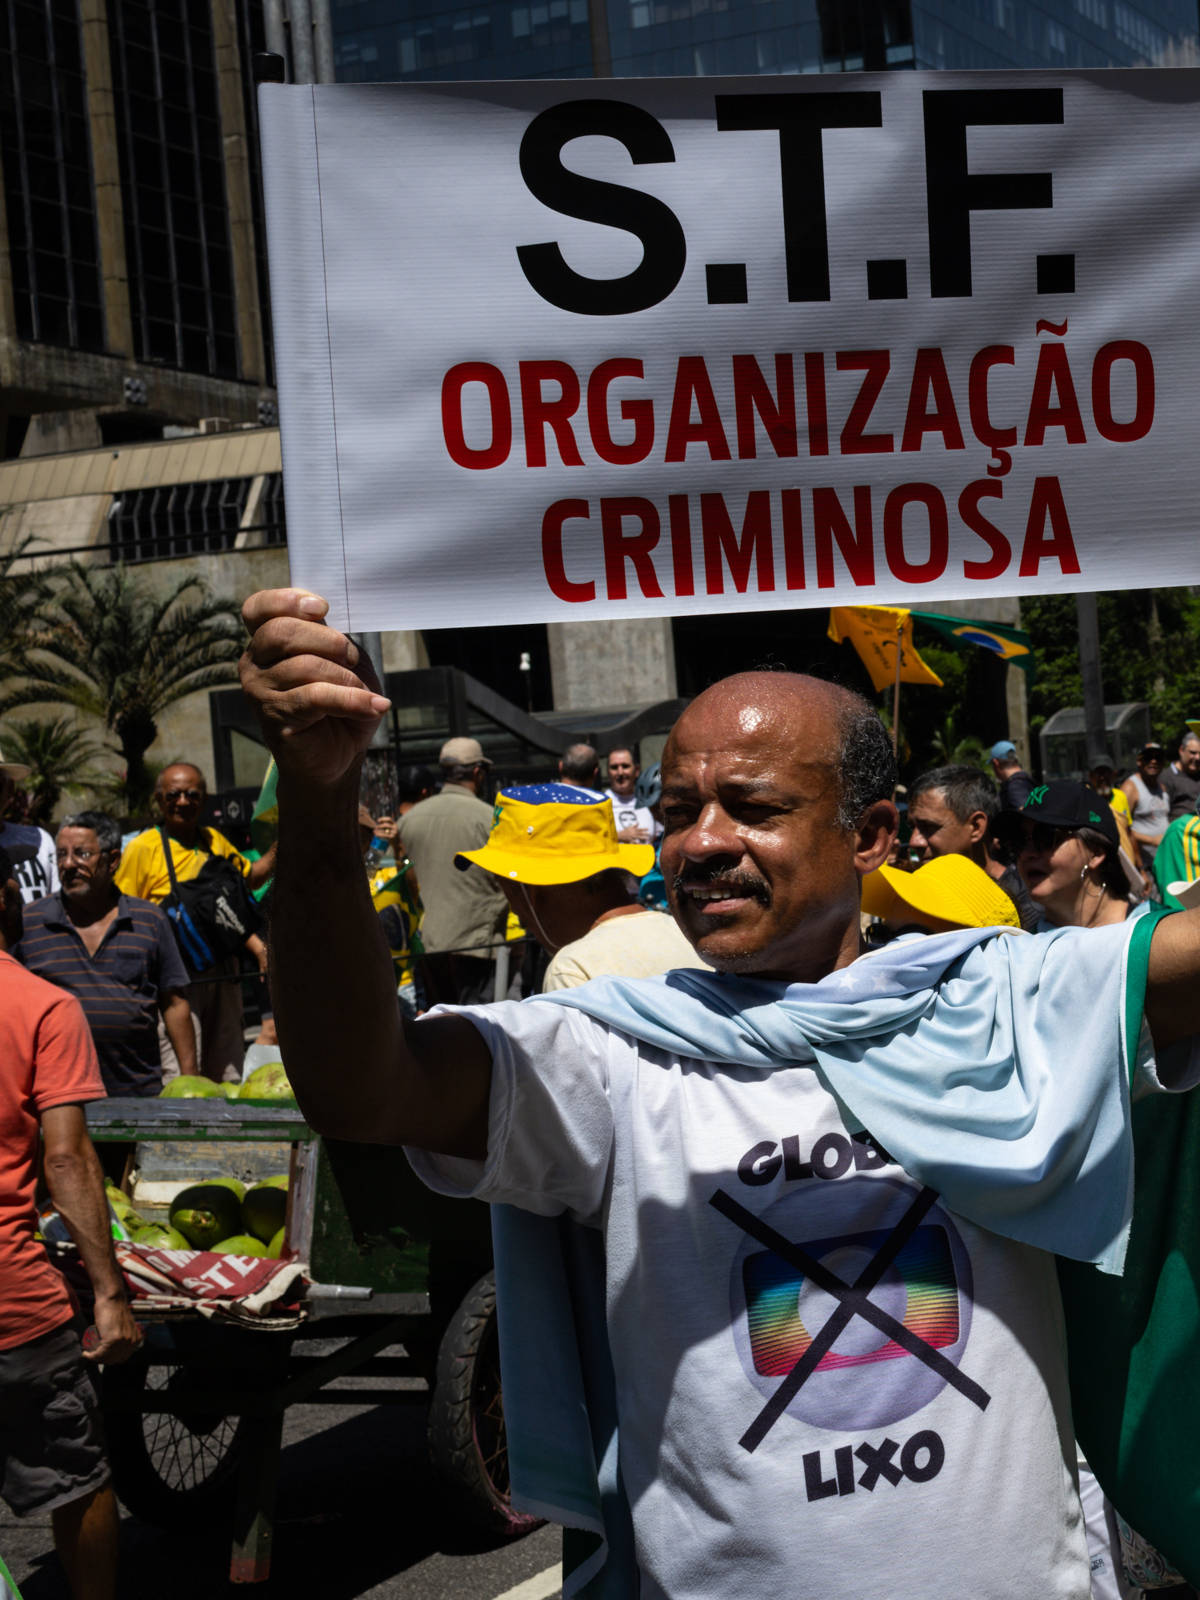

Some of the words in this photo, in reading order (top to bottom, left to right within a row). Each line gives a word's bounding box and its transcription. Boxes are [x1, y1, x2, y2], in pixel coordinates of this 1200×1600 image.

[516, 88, 1076, 316] S.T.F.
[441, 318, 1155, 477] ORGANIZAÇÃO
[541, 476, 1081, 604] CRIMINOSA
[737, 1131, 896, 1186] GLOB
[802, 1429, 945, 1503] LIXO
